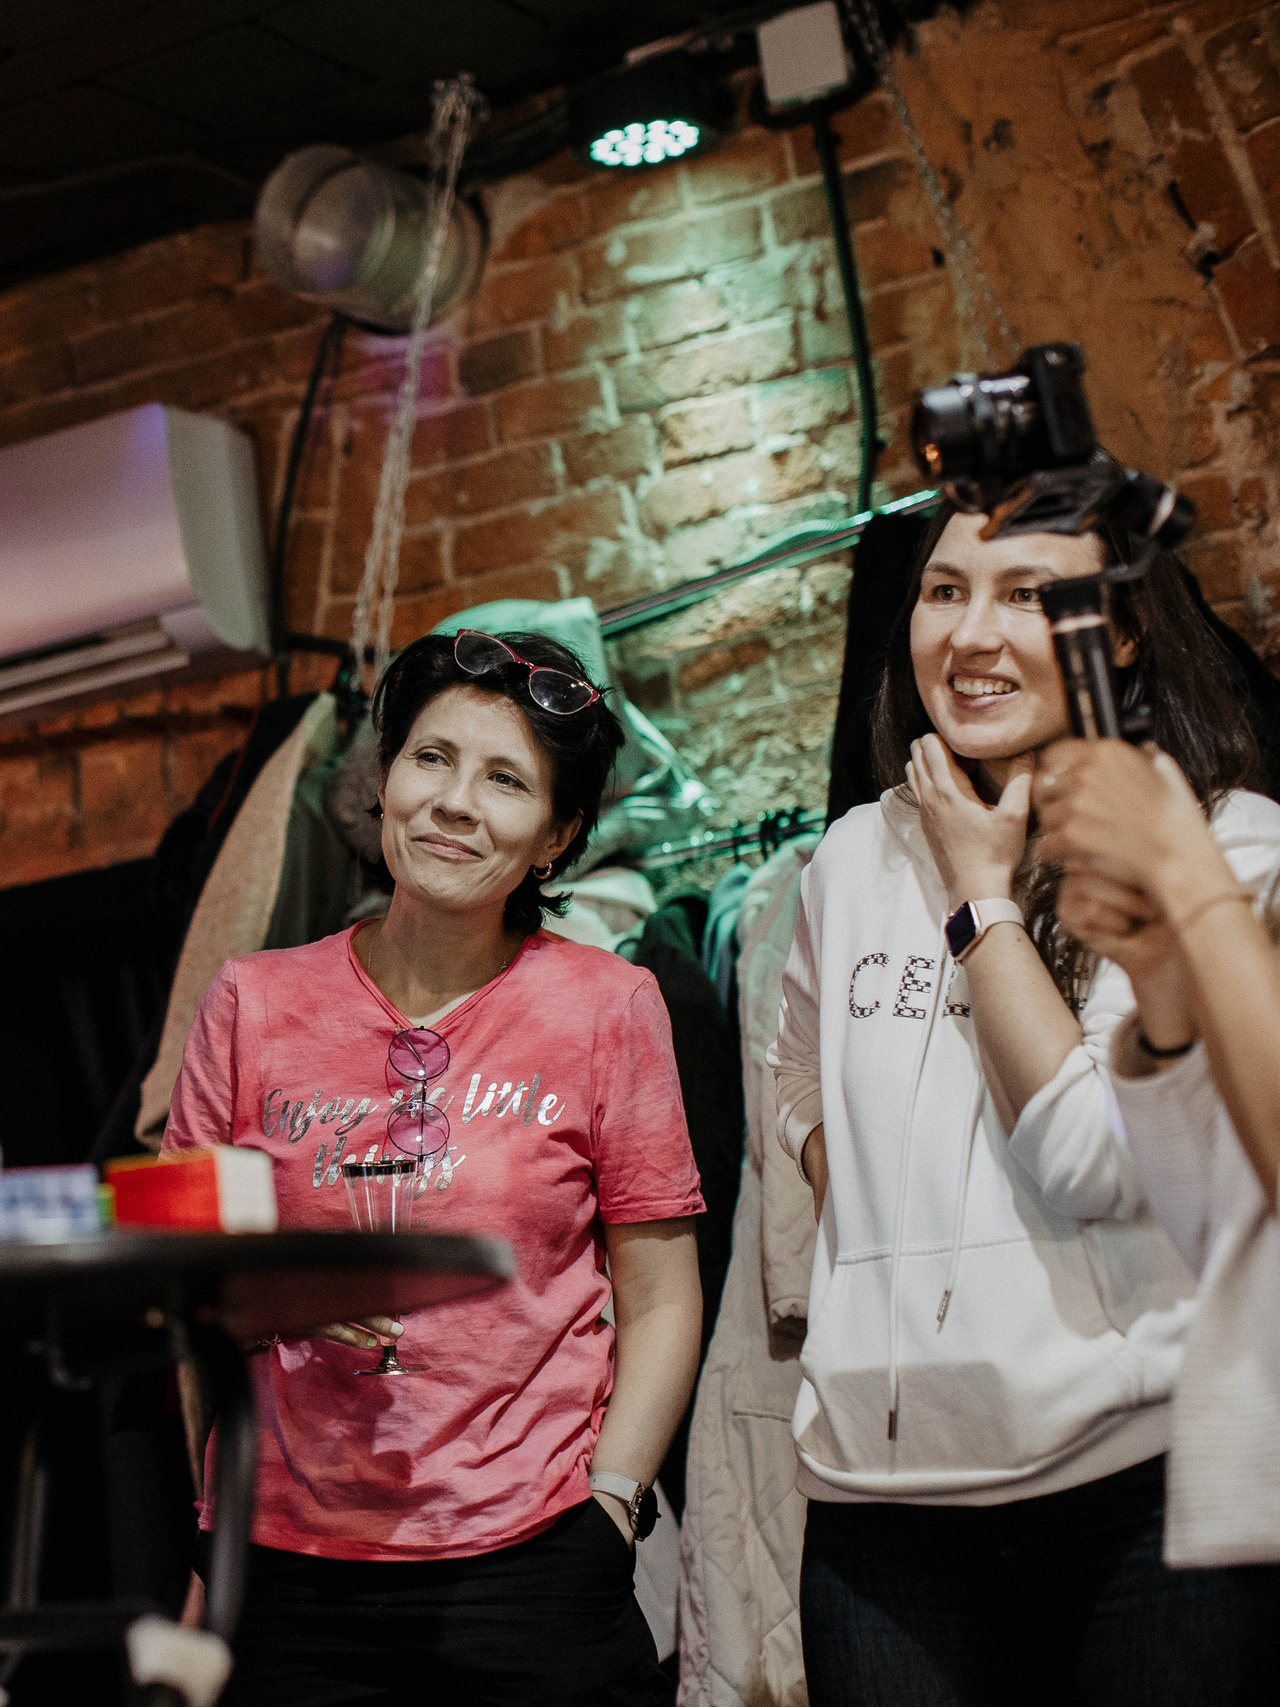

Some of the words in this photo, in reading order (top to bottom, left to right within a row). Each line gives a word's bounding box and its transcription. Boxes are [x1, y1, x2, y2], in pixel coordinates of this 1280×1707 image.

[848, 952, 971, 1019] CEL
[262, 1088, 380, 1145] Enjoy
[461, 1072, 567, 1127] little
